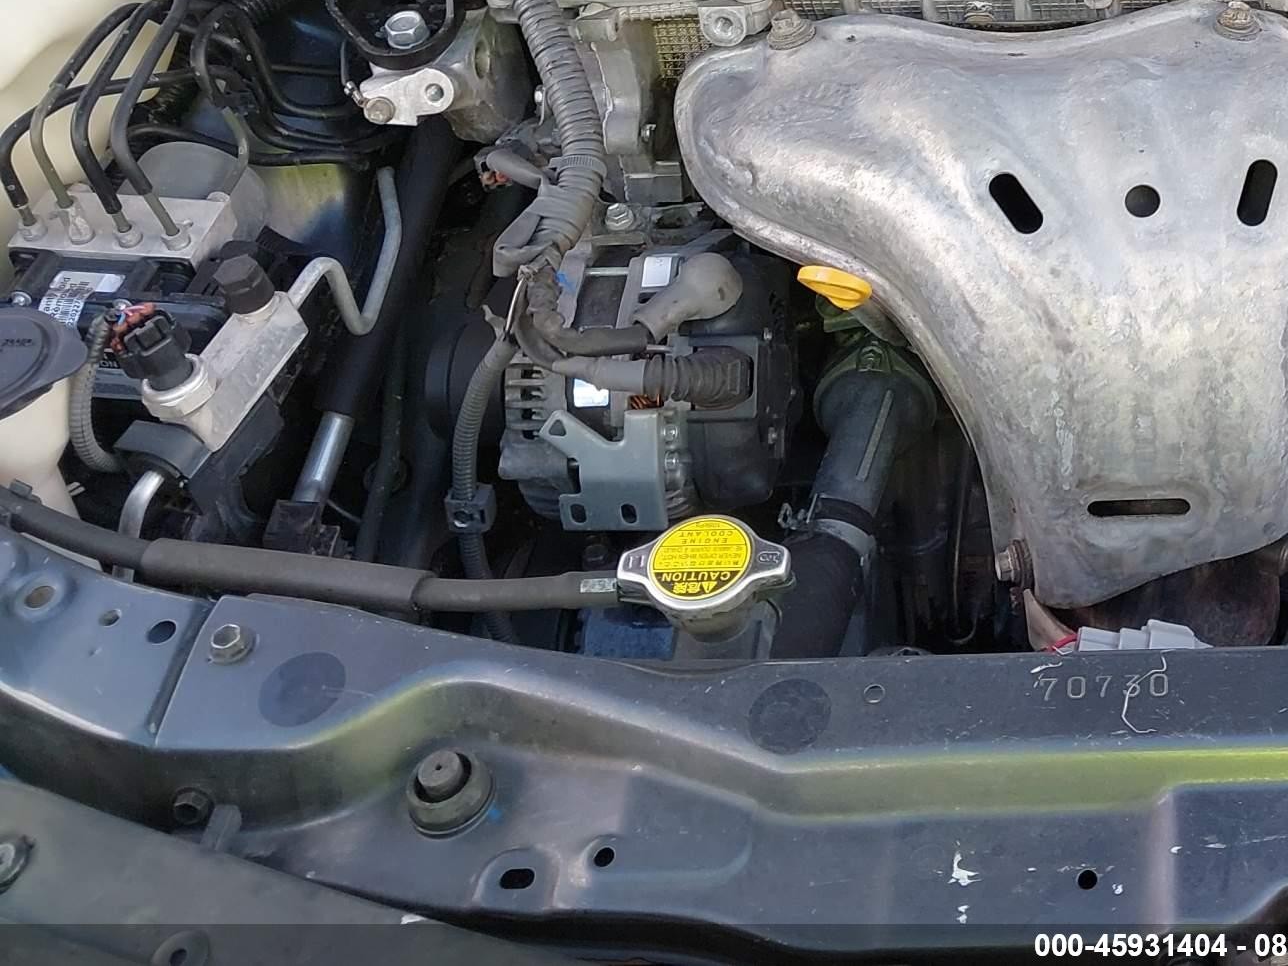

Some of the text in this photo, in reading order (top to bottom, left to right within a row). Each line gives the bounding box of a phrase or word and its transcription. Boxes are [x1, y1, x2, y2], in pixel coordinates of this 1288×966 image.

[680, 530, 733, 538] COOLANT
[663, 572, 730, 582] CAUTION
[1041, 673, 1169, 701] 70730
